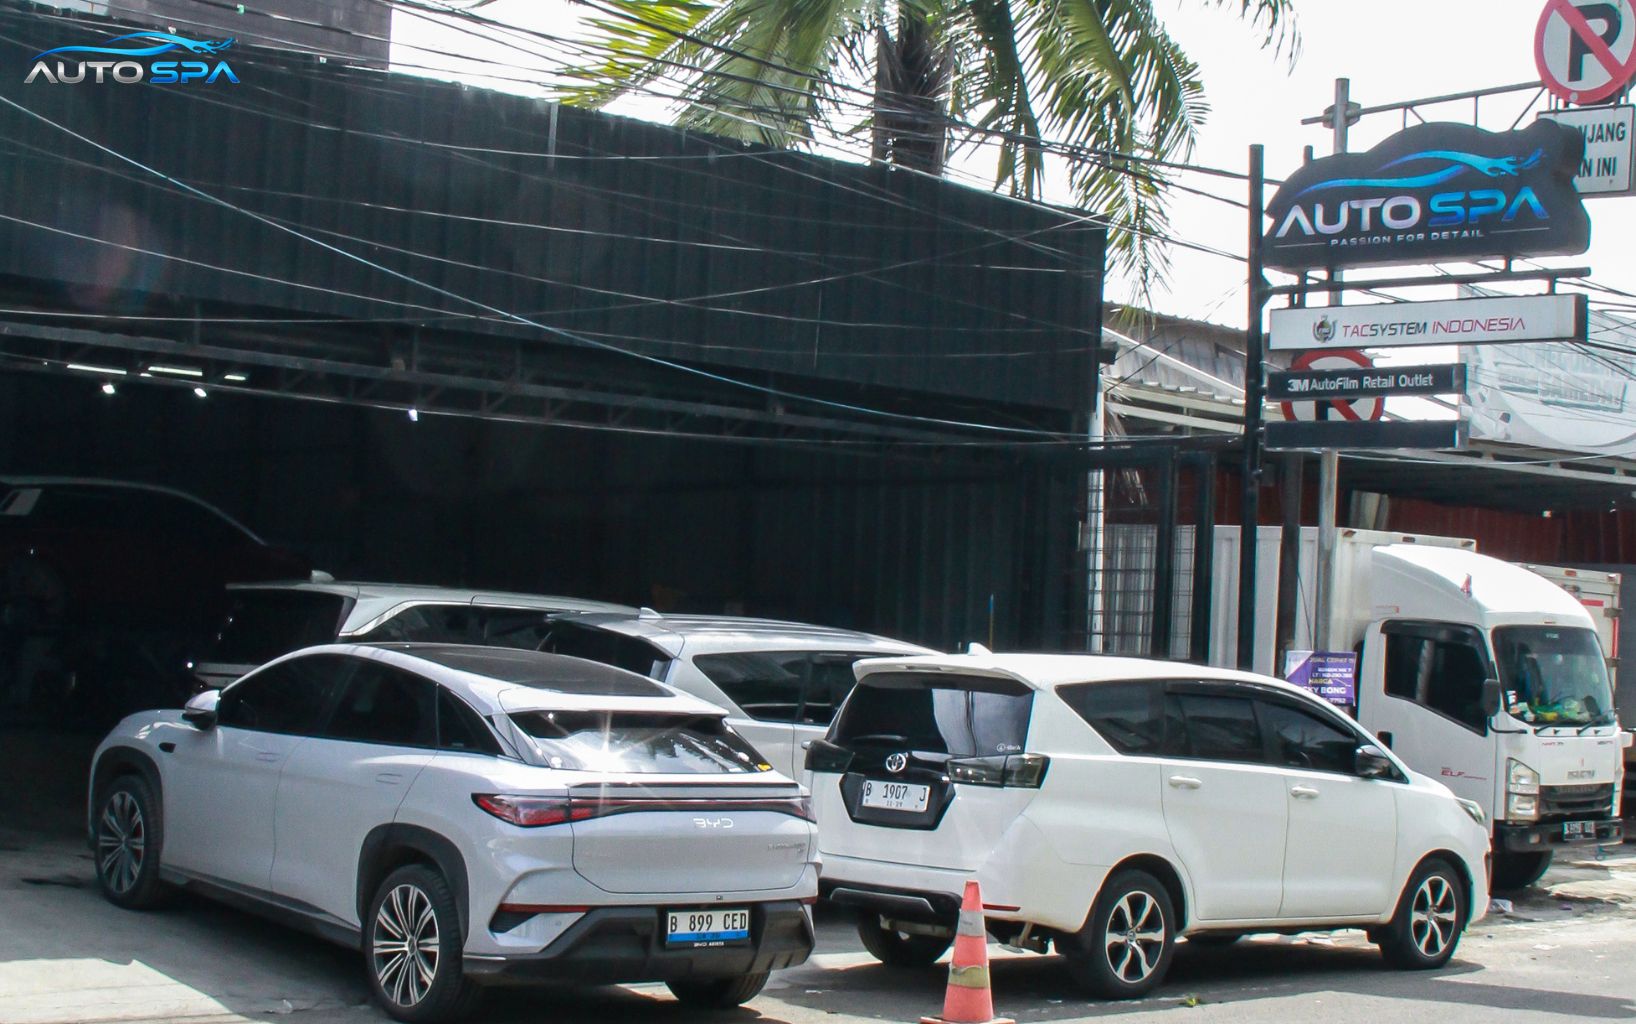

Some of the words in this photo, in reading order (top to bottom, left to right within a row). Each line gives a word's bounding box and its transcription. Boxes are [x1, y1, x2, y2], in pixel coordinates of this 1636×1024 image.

[1597, 156, 1617, 176] INI
[1275, 195, 1421, 237] AUTO
[1428, 186, 1549, 227] SPA
[1330, 235, 1391, 247] PASSION
[1396, 232, 1425, 243] FOR
[1430, 229, 1485, 240] DETAIL
[1343, 322, 1427, 338] TACSYSTEM
[1432, 317, 1526, 335] INDONESIA
[1287, 378, 1308, 392] 3M
[1310, 376, 1358, 391] AutoFilm
[1363, 375, 1394, 389] Retail
[1398, 373, 1433, 387] Outlet
[865, 782, 873, 797] B
[882, 783, 909, 800] 1907
[919, 787, 927, 802] J
[693, 817, 734, 829] BYD
[670, 915, 678, 933] B
[689, 913, 713, 932] 899
[723, 912, 747, 931] CED
